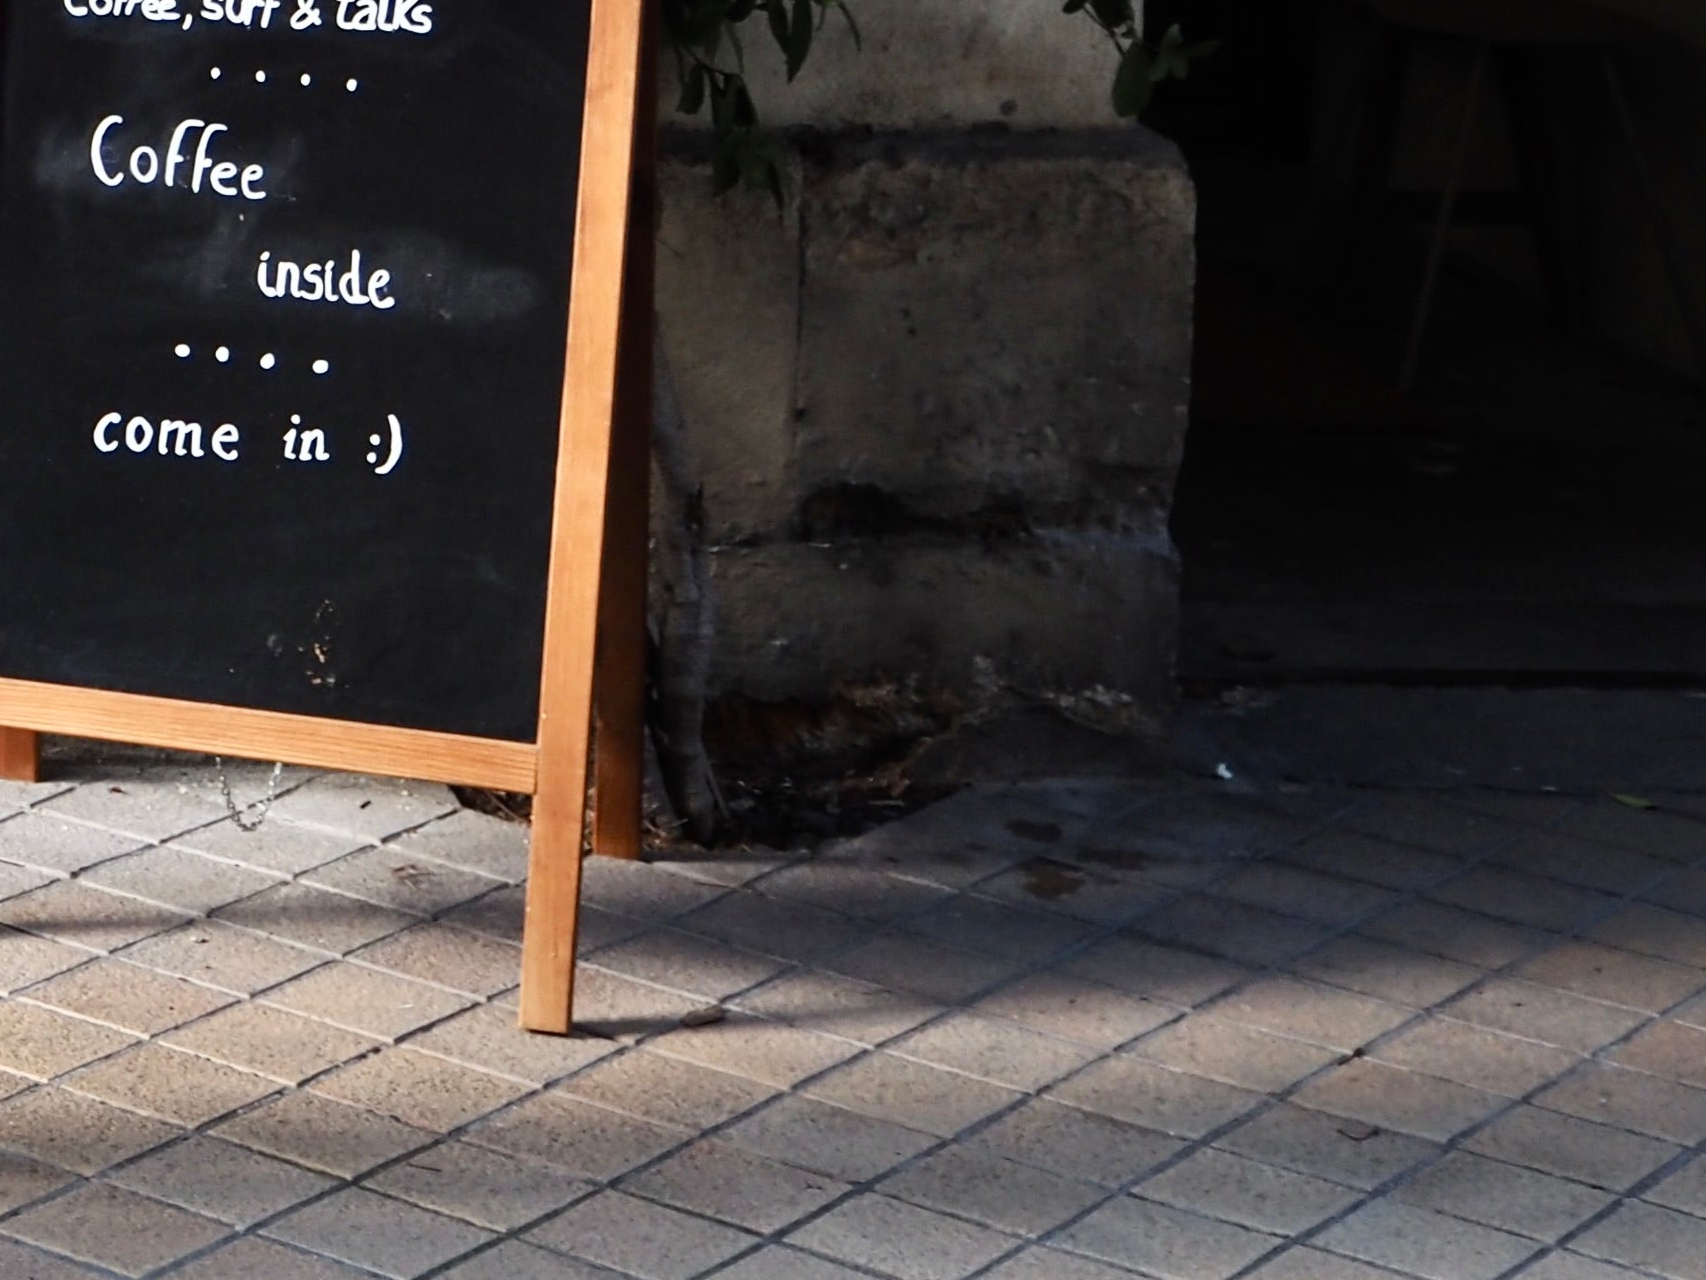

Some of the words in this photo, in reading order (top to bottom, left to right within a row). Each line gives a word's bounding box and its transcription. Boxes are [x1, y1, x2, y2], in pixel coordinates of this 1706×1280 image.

[90, 114, 267, 200] Coffee
[256, 248, 396, 309] inside
[93, 411, 240, 461] come
[282, 414, 331, 462] in
